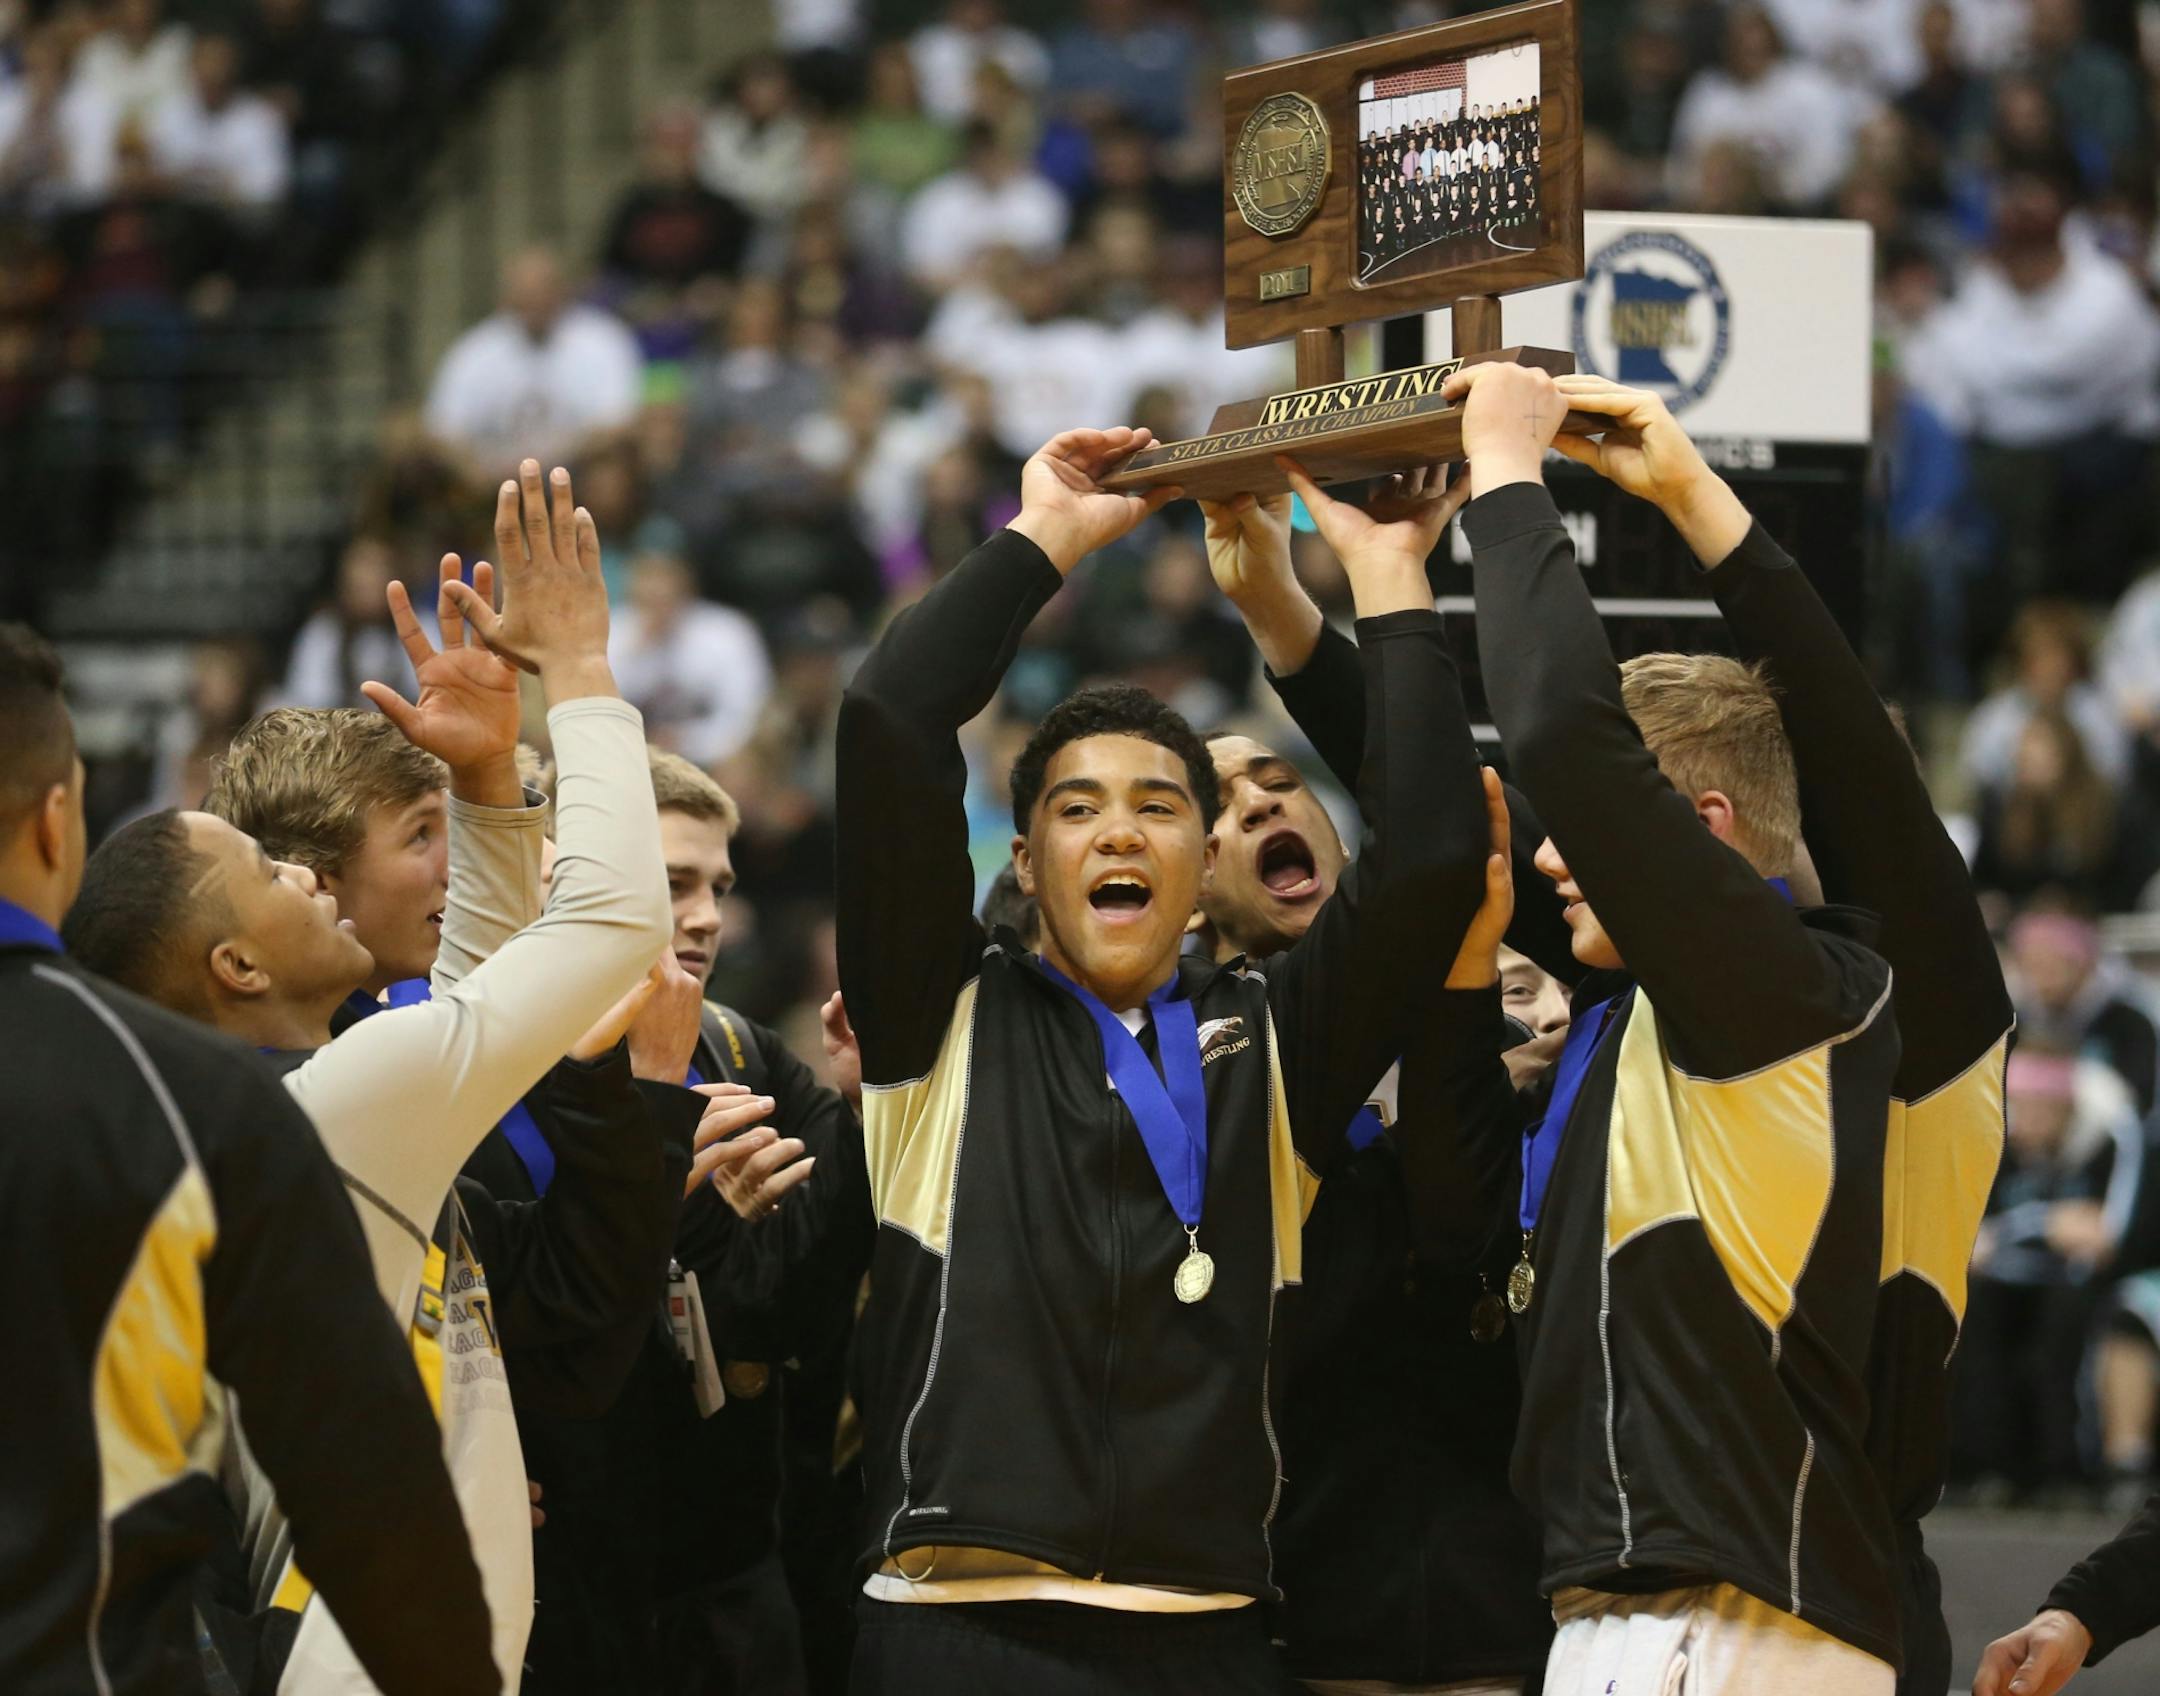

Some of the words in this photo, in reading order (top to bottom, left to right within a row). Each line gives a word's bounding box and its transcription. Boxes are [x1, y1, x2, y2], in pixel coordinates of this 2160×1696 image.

[1263, 269, 1308, 297] 201
[1267, 363, 1457, 425] WRESTLING
[1168, 437, 1226, 461] STATE
[1225, 426, 1283, 449] CLASS
[1281, 420, 1318, 440] AAA
[1320, 398, 1422, 431] CHAMPION
